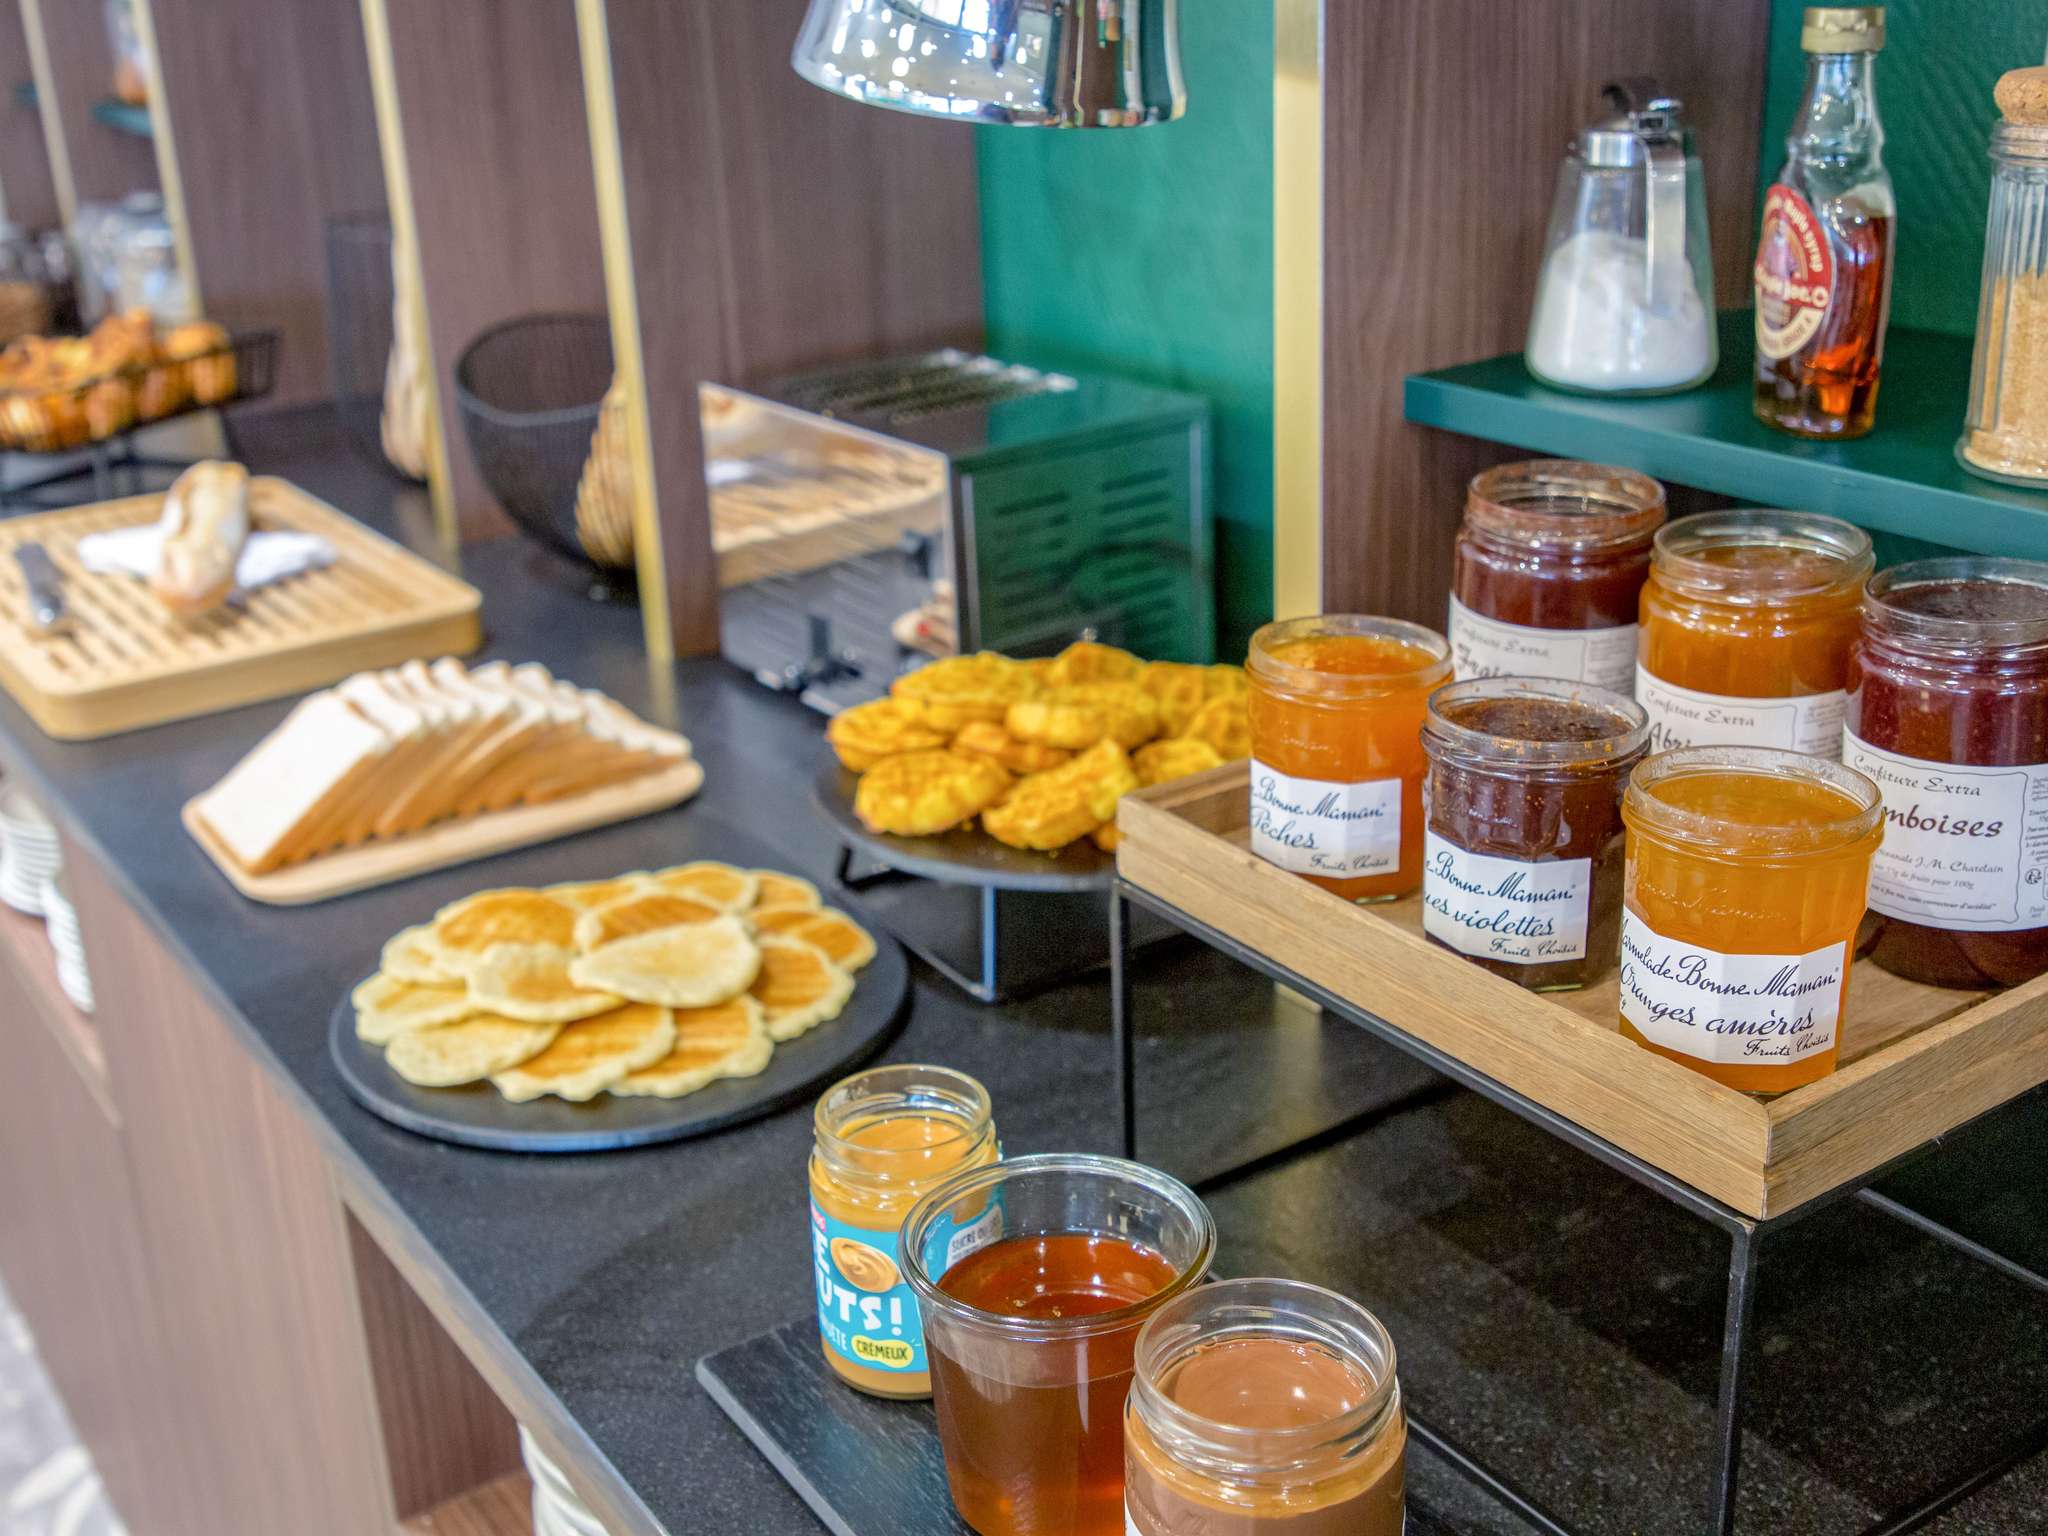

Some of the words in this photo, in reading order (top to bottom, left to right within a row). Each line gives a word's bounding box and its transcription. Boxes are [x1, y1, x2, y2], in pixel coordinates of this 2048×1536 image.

[1646, 690, 1699, 719] Confiture
[1704, 708, 1755, 727] Extra
[1854, 754, 1919, 789] Confiture
[1923, 777, 1981, 797] Extra
[1260, 776, 1304, 815] Bonne
[1306, 791, 1384, 820] Maman
[1883, 804, 2003, 838] mboises
[1310, 853, 1347, 871] Fruits
[1434, 850, 1486, 896] Bonne
[1487, 871, 1574, 903] Maman
[1453, 909, 1556, 938] violettes
[1489, 937, 1532, 958] Fruits
[1536, 939, 1578, 957] Choisis
[1676, 954, 1750, 996] Bonne
[1753, 964, 1837, 997] Maman
[1621, 962, 1697, 1026] Oranges
[1705, 1007, 1816, 1036] amères
[1743, 1038, 1792, 1056] Fruits
[1796, 1032, 1831, 1053] Choisis
